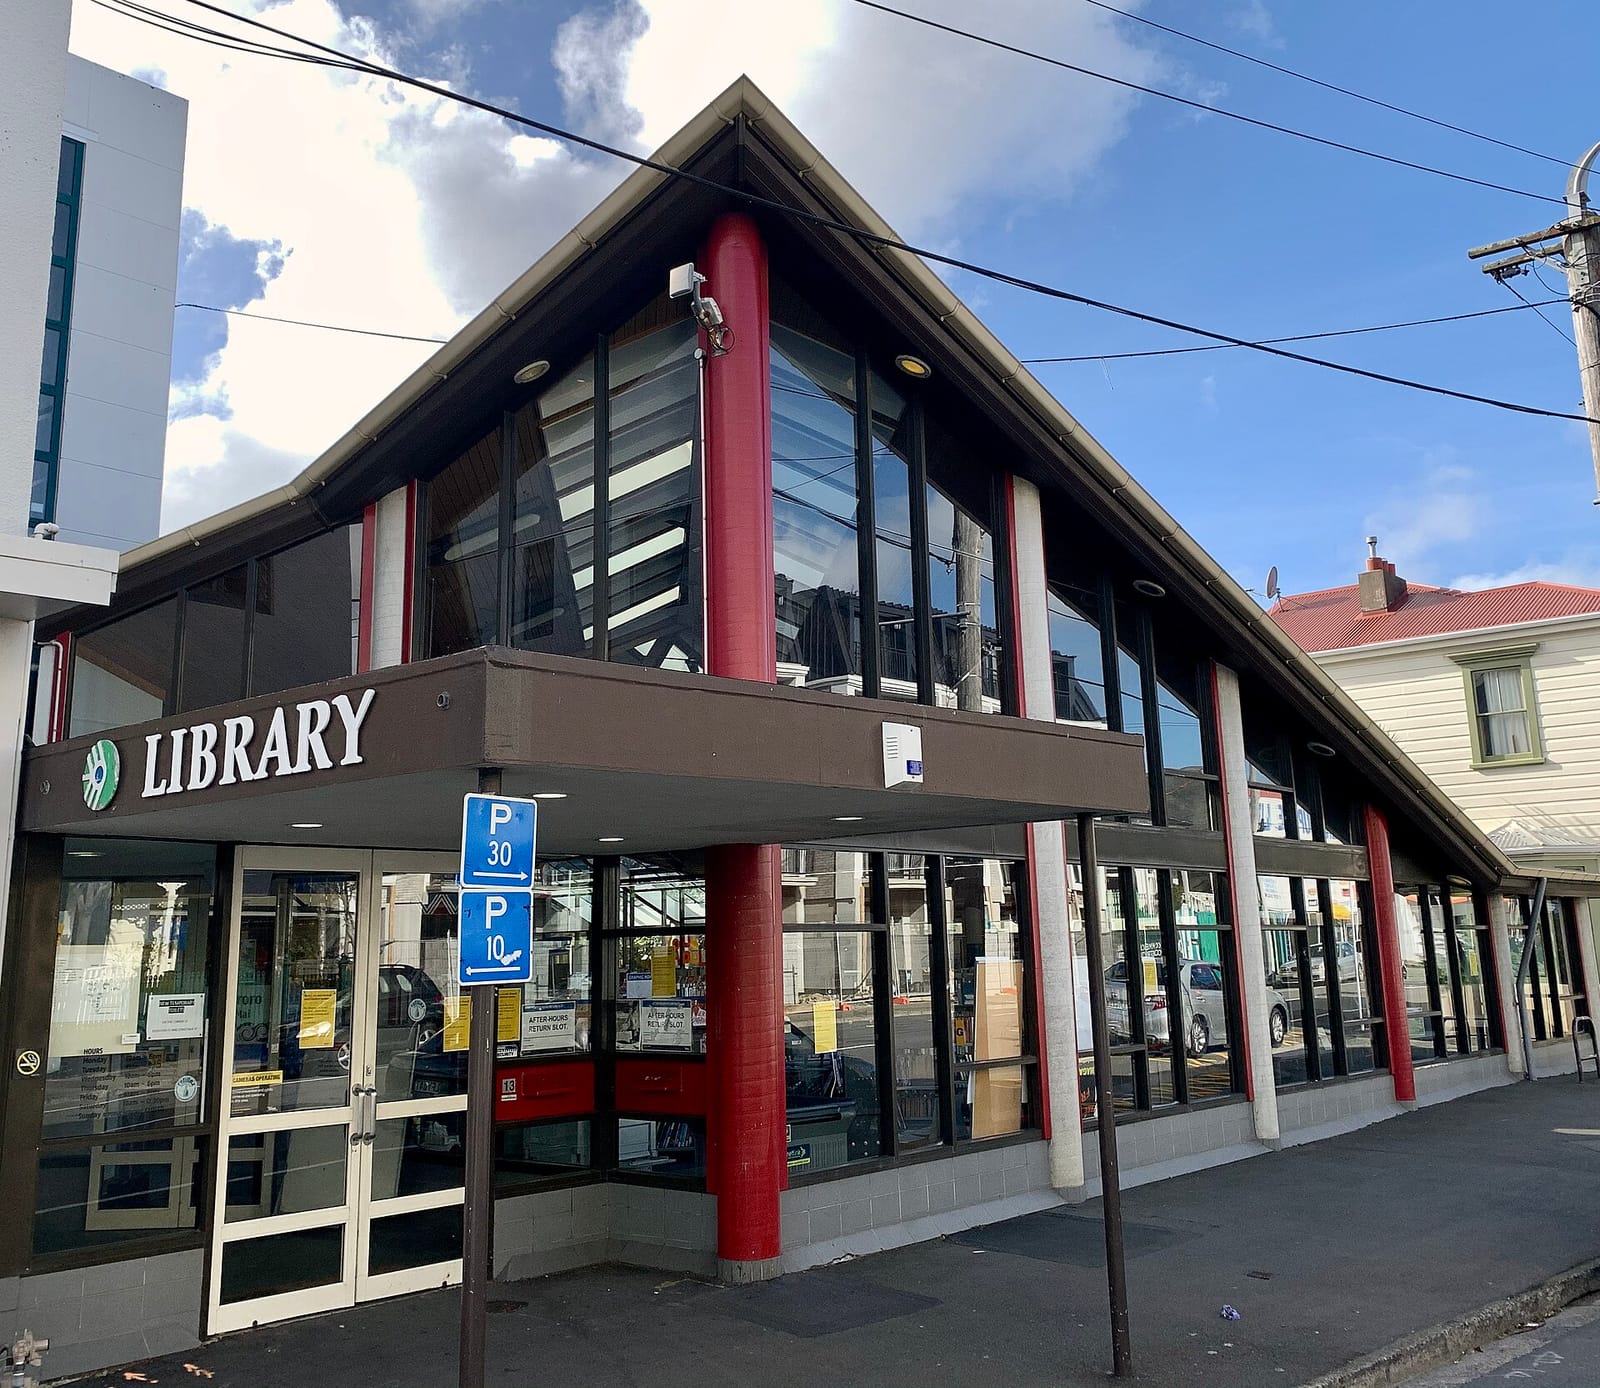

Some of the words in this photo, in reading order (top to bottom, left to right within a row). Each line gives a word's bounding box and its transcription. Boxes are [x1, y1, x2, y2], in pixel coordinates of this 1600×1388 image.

[141, 688, 376, 798] LIBRARY
[490, 803, 513, 835] P
[487, 841, 512, 867] 30
[485, 896, 508, 930] P
[486, 934, 506, 962] 10
[528, 1024, 552, 1033] RETURN
[83, 1047, 104, 1055] HOURS
[503, 1080, 516, 1092] 13
